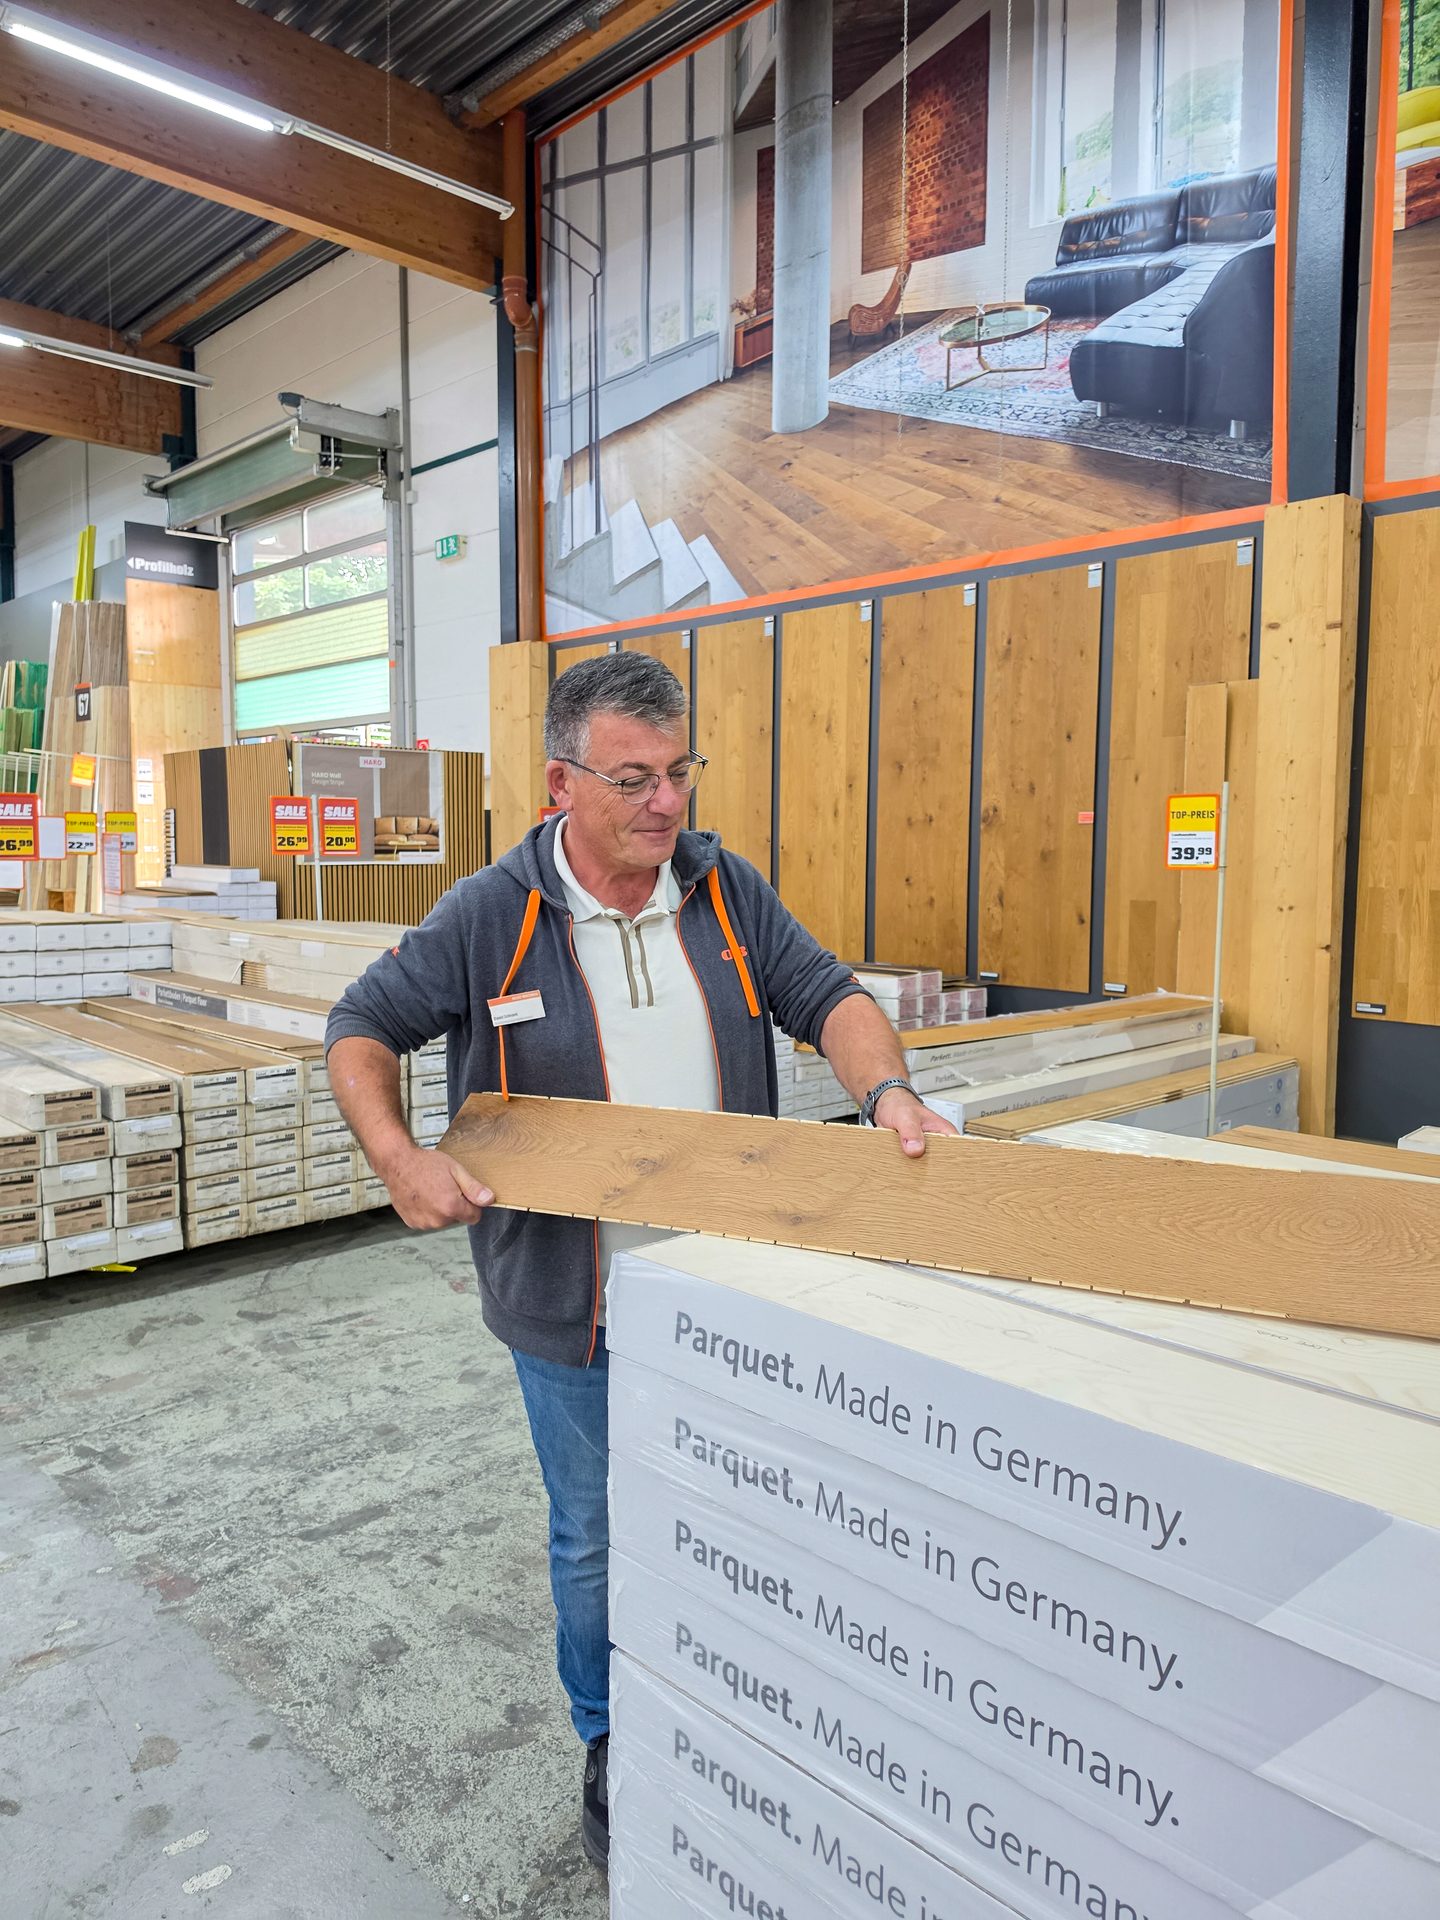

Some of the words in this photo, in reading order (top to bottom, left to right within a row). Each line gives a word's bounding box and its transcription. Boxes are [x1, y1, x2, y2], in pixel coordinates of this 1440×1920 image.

[135, 557, 194, 577] Profilholz
[78, 693, 90, 716] 67
[275, 805, 307, 817] SALE
[324, 806, 356, 818] SALE
[1171, 810, 1215, 819] TOP-PREIS
[1171, 847, 1213, 861] 39,99
[674, 1310, 804, 1394] Parquet.
[815, 1364, 911, 1437] Made
[925, 1404, 957, 1455] in
[973, 1426, 1188, 1551] Germany.
[674, 1416, 804, 1509] Parquet.
[815, 1481, 910, 1560] Made
[924, 1530, 956, 1583] in
[971, 1556, 1184, 1692] Germany.
[674, 1519, 804, 1621] Parquet.
[814, 1594, 909, 1677] Made
[923, 1650, 954, 1704] in
[969, 1680, 1180, 1828] Germany.
[674, 1621, 804, 1731] Parquet.
[813, 1706, 907, 1796] Made
[920, 1770, 952, 1825] in
[966, 1803, 1149, 1920] German
[673, 1727, 803, 1847] Parquet.
[812, 1823, 907, 1919] Made
